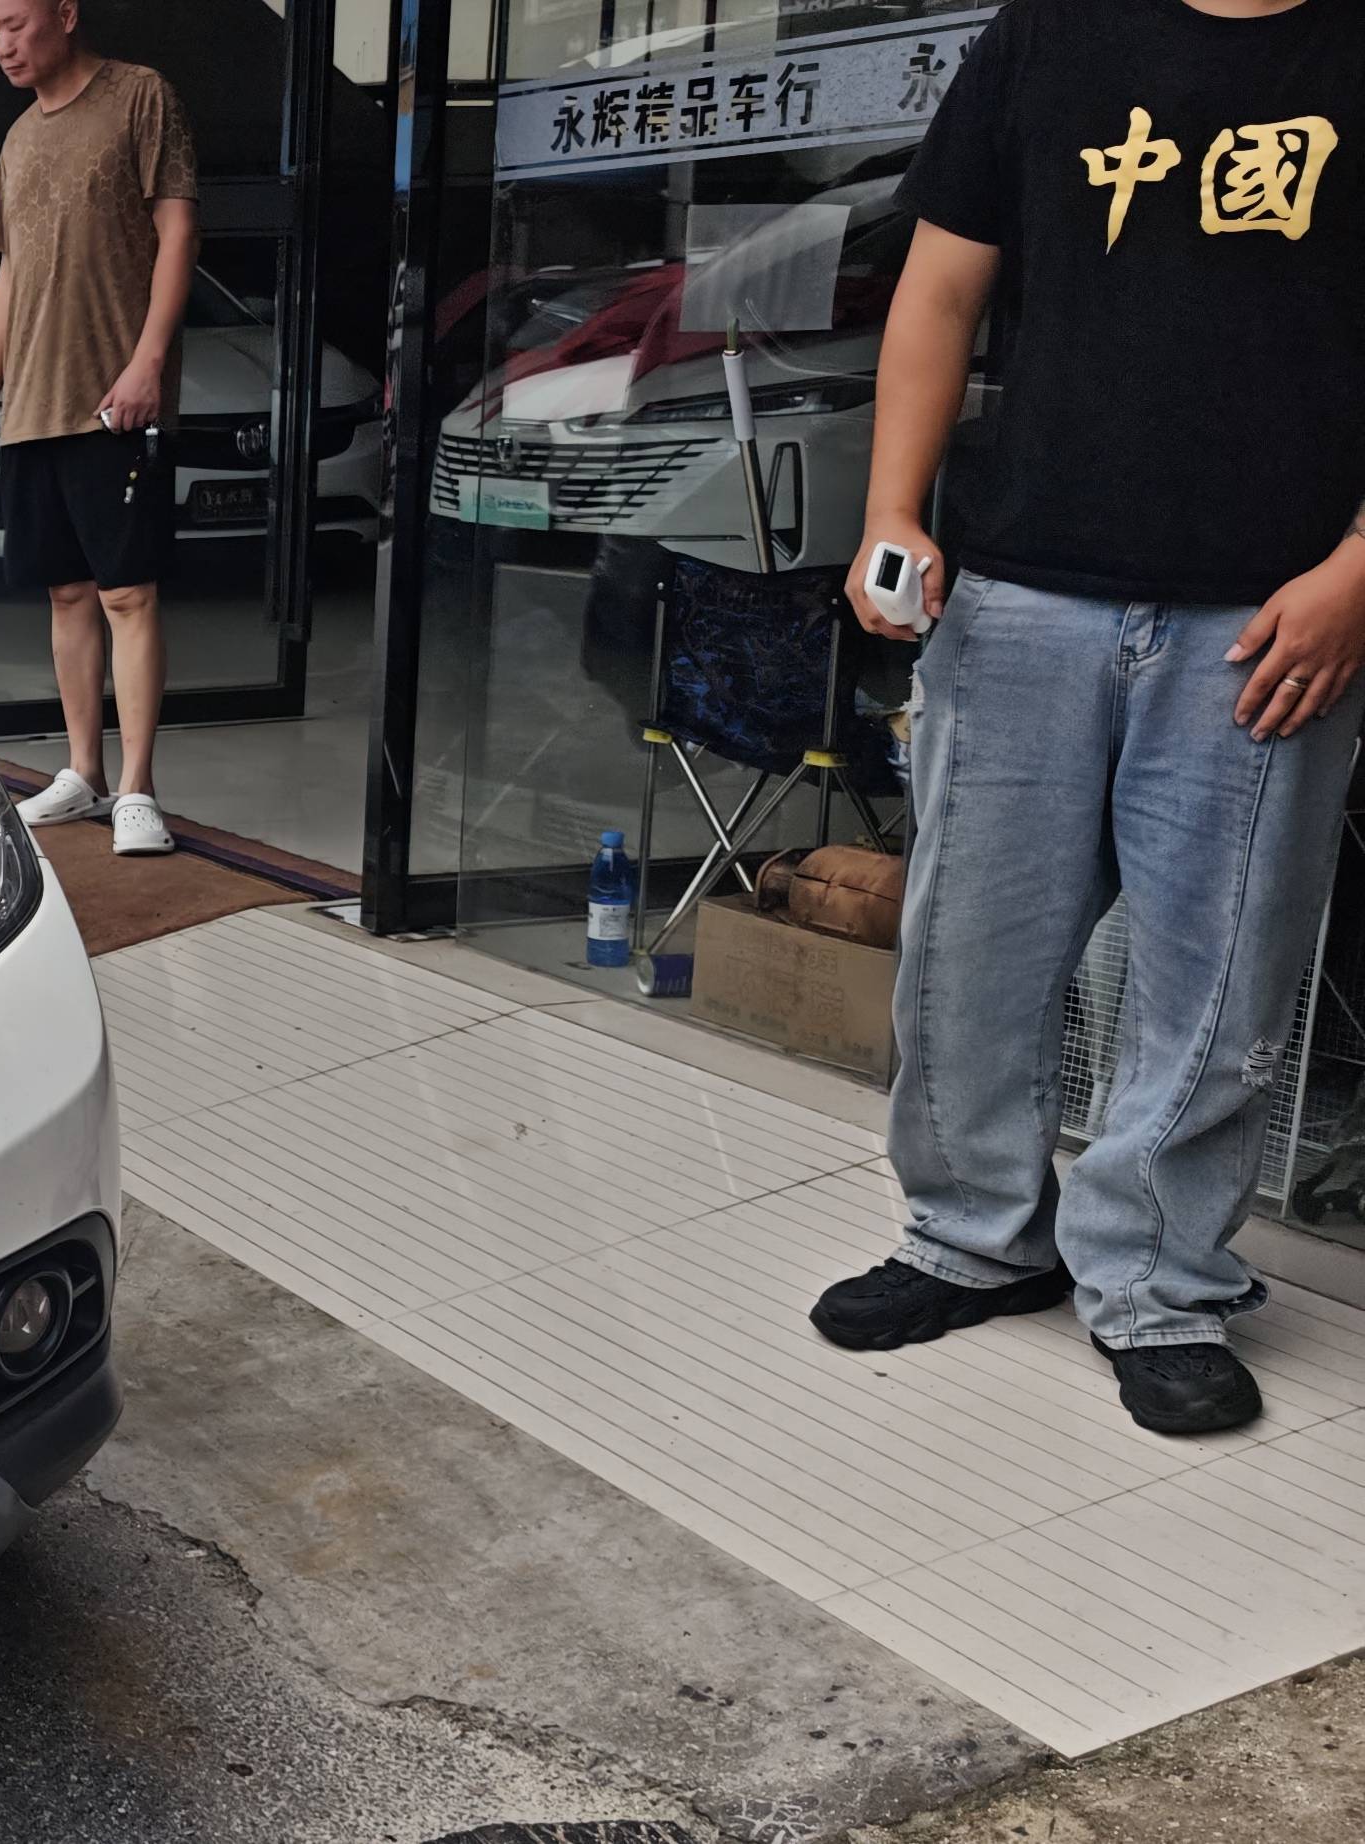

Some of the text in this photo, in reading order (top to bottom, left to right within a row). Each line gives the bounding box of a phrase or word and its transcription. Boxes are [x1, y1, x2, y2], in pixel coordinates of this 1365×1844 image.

[549, 38, 974, 155] 永辉精品车行 永
[1079, 106, 1339, 256] 中國
